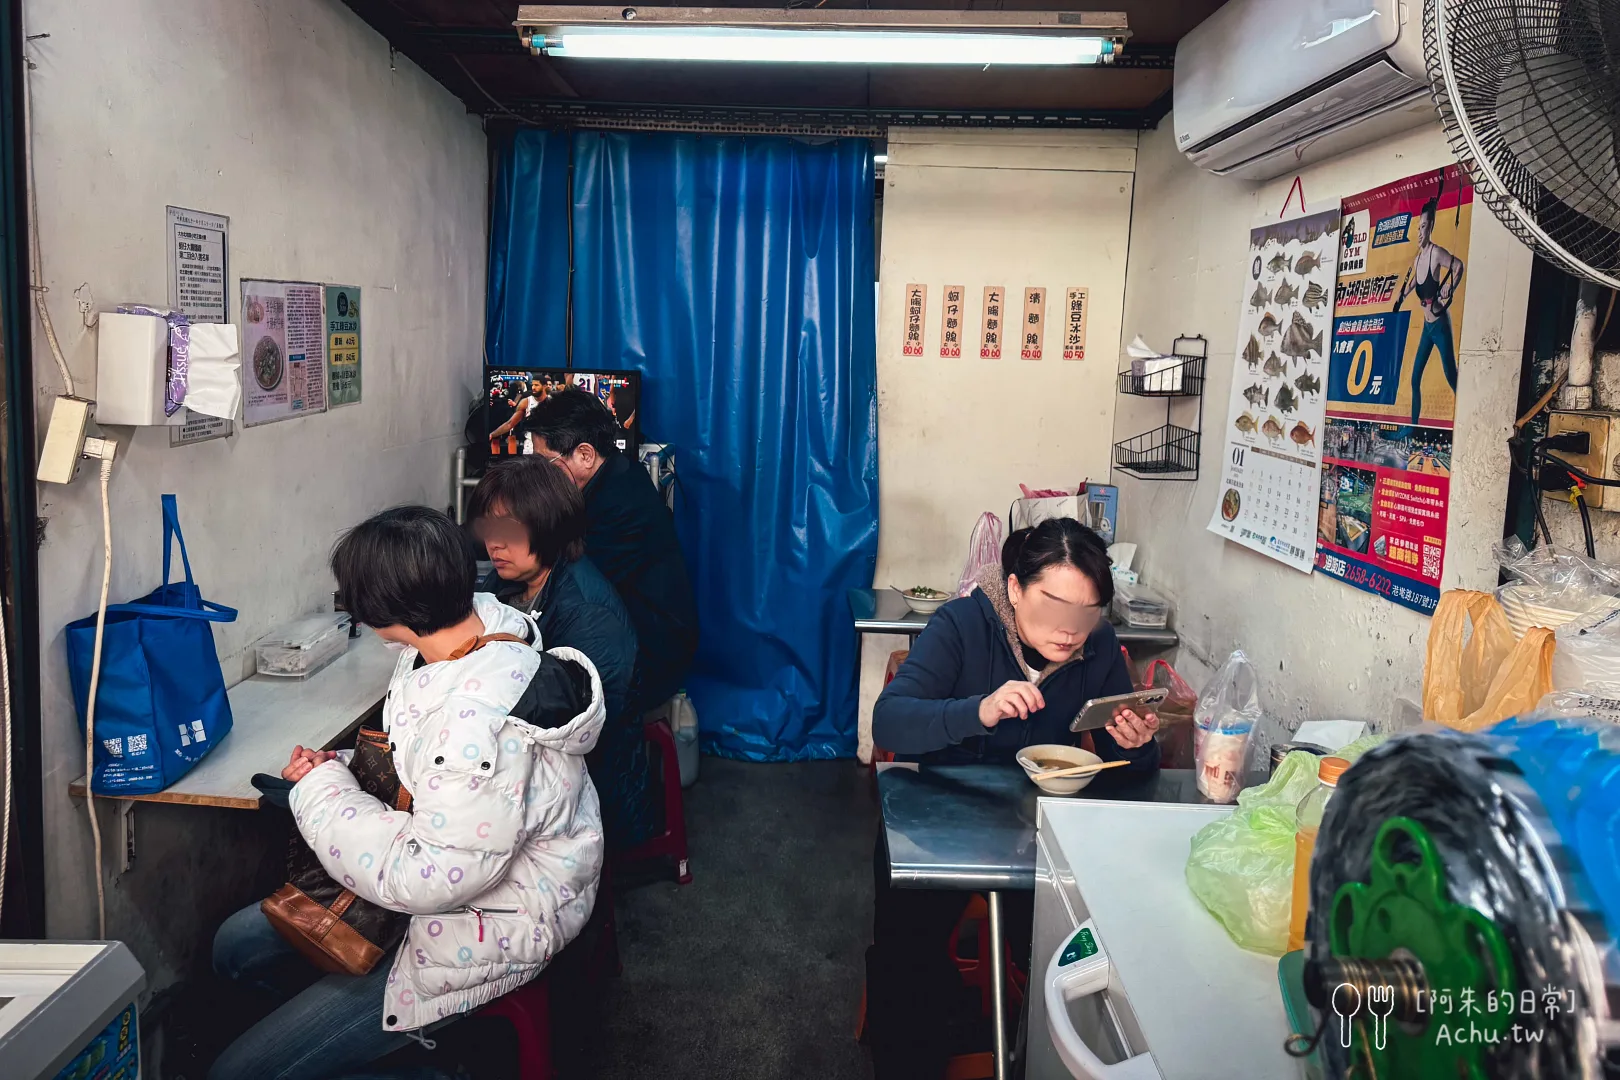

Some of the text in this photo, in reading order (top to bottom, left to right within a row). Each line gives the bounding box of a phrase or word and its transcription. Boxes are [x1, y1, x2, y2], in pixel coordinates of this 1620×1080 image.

[1344, 246, 1361, 258] GYM
[908, 289, 921, 341] 大腸蚵仔麵線
[945, 291, 959, 342] 蚵仔麵線
[986, 292, 999, 344] 大腸麵線
[1026, 292, 1040, 344] 清麵線
[1069, 300, 1082, 344] 綠豆冰沙
[903, 346, 923, 355] 80 60
[940, 348, 960, 356] 80 60
[980, 349, 1000, 357] 80 60
[1021, 350, 1041, 358] 50 40
[1074, 351, 1084, 359] 50
[1333, 340, 1354, 353] 入會費
[173, 346, 187, 387] Tissue
[1347, 340, 1373, 396] 0
[579, 378, 590, 392] 21
[1369, 376, 1383, 395] 元
[1232, 447, 1245, 467] 01
[1344, 563, 1392, 596] 2658-6222
